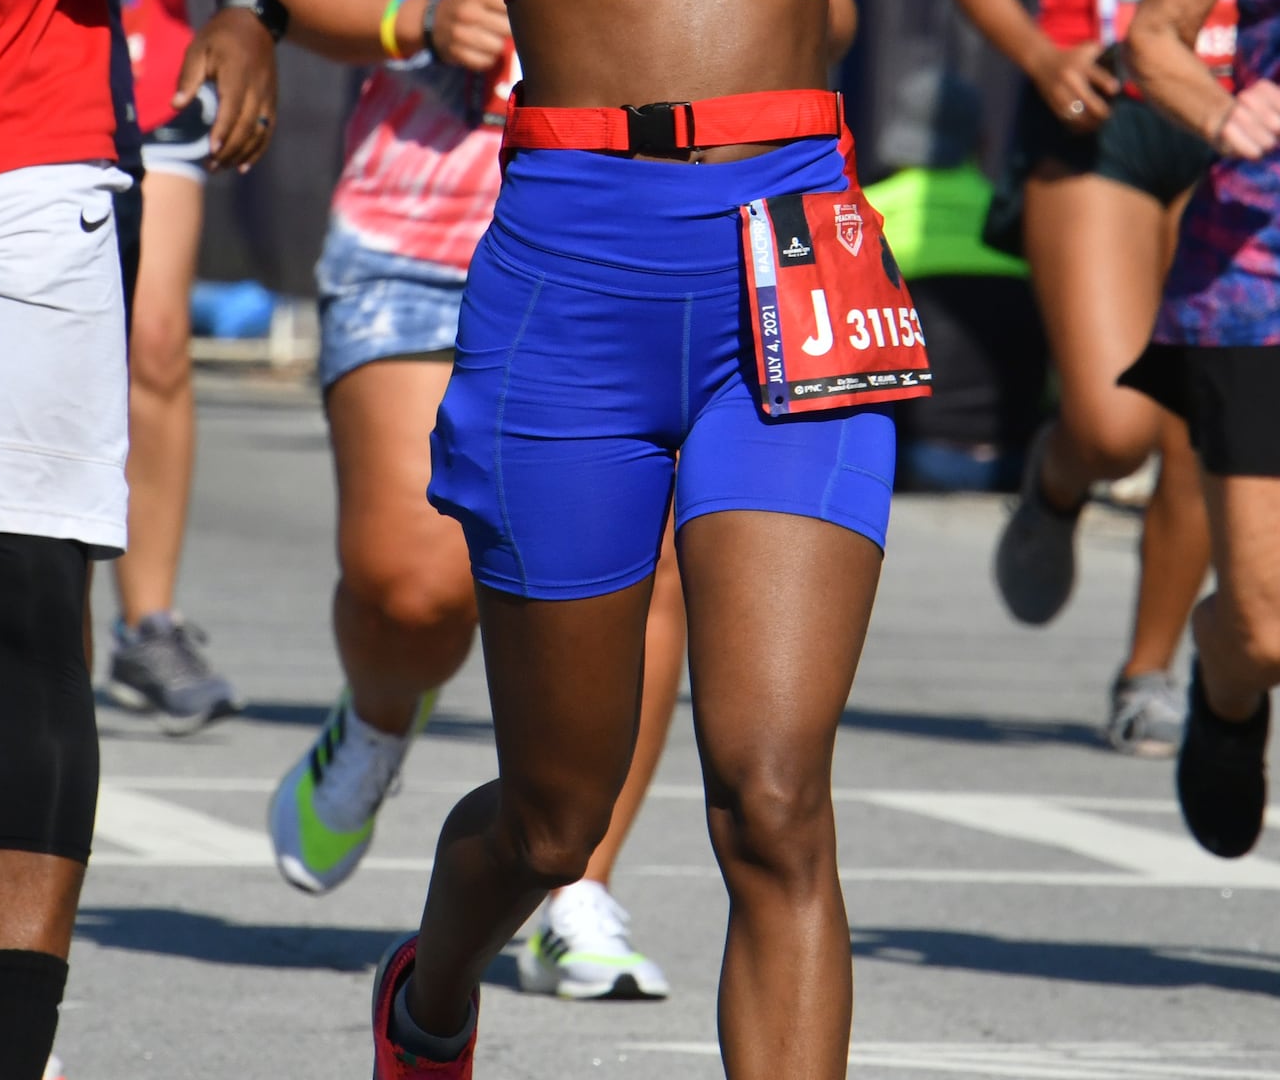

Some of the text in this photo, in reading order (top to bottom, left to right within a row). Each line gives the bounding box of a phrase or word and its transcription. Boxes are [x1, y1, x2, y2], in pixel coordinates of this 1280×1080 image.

[762, 305, 778, 337] 2021
[801, 289, 834, 356] J
[769, 356, 783, 384] JULY
